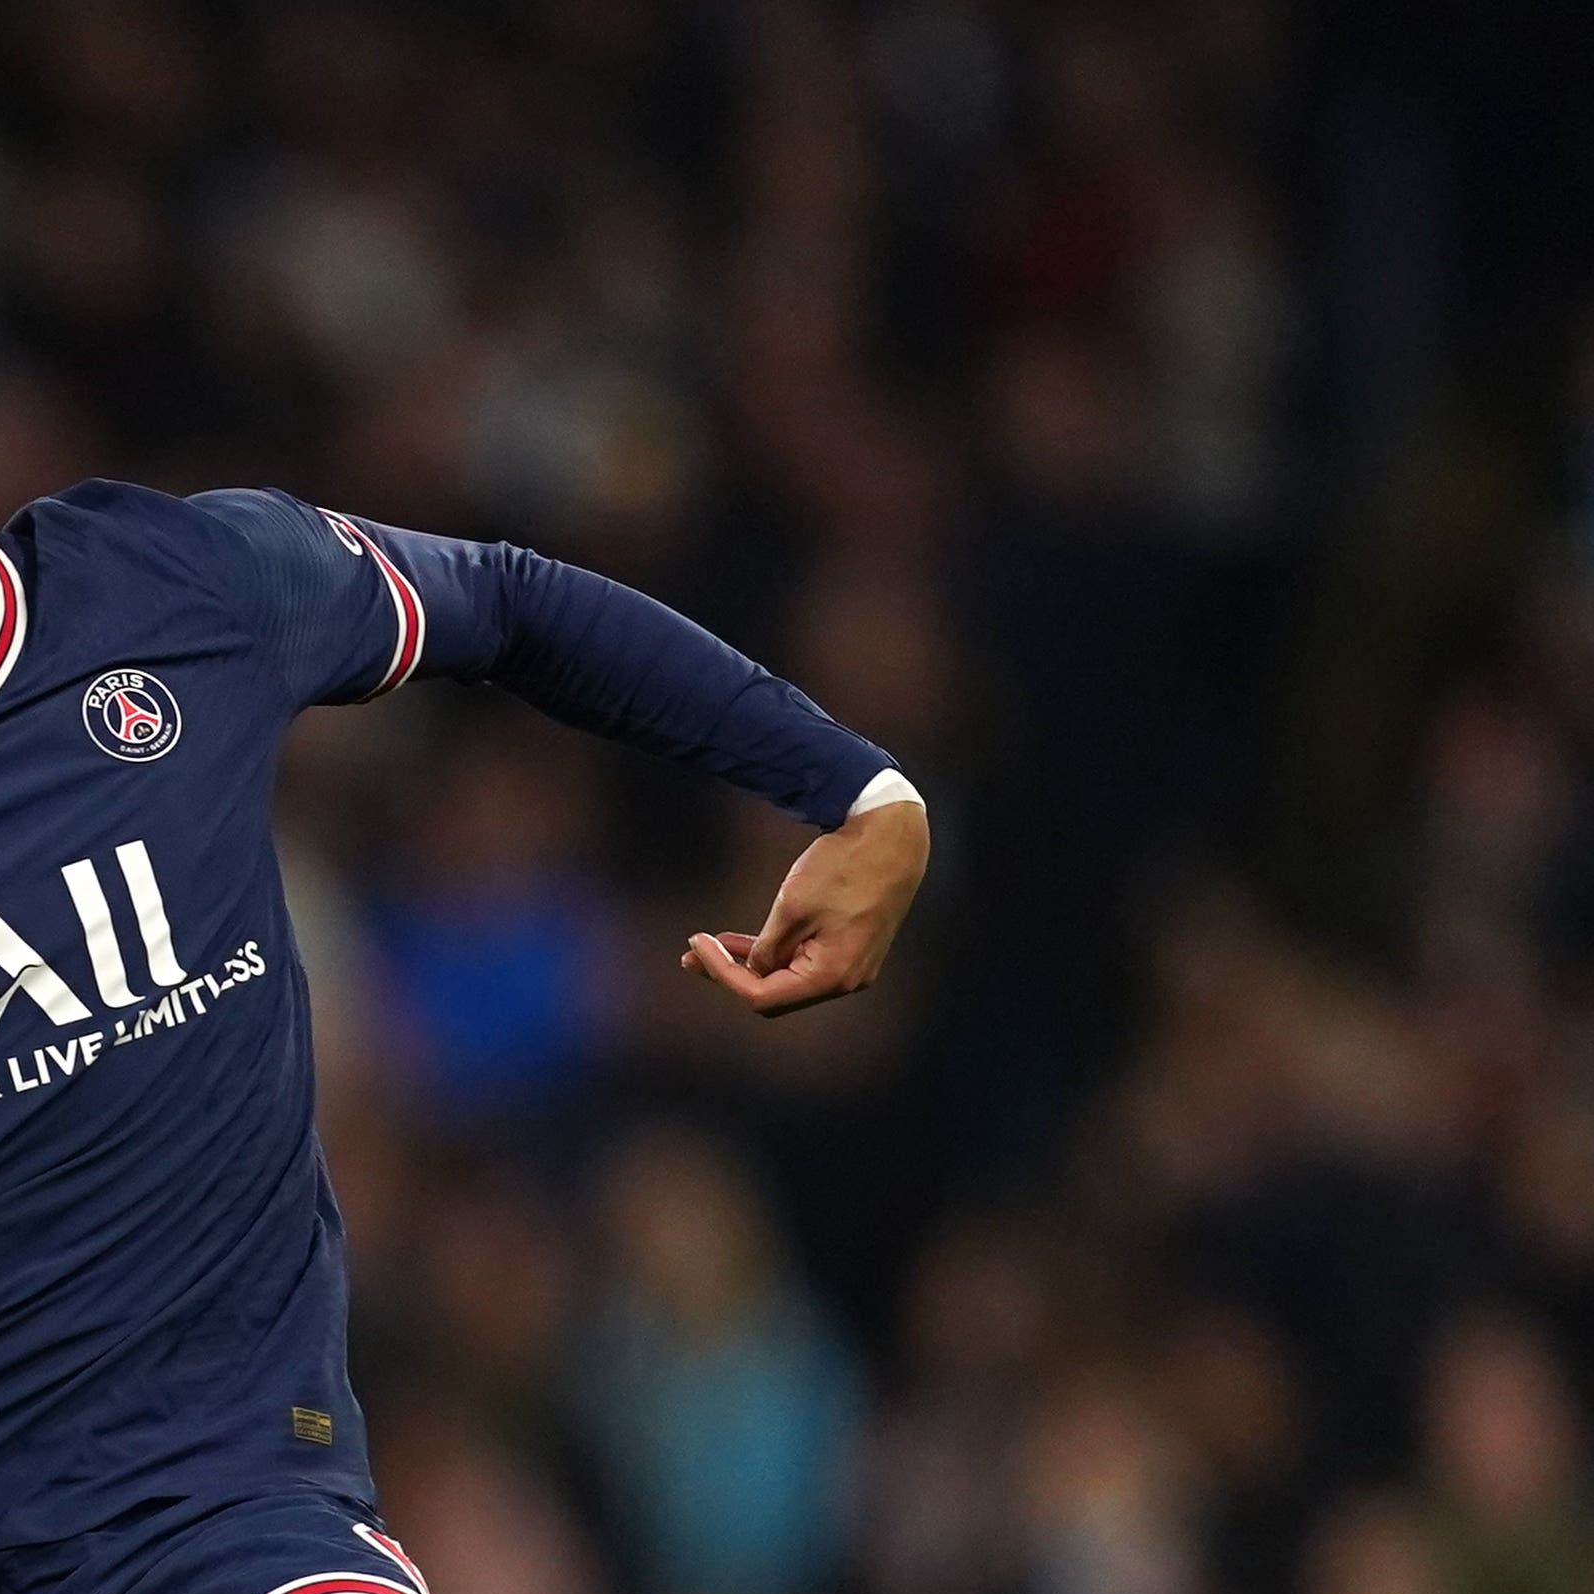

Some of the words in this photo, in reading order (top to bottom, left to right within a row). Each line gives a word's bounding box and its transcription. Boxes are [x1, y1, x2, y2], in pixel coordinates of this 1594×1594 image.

[88, 673, 145, 709] PARIS
[7, 1031, 104, 1094] LIVE
[113, 940, 267, 1046] LIMITLSS
